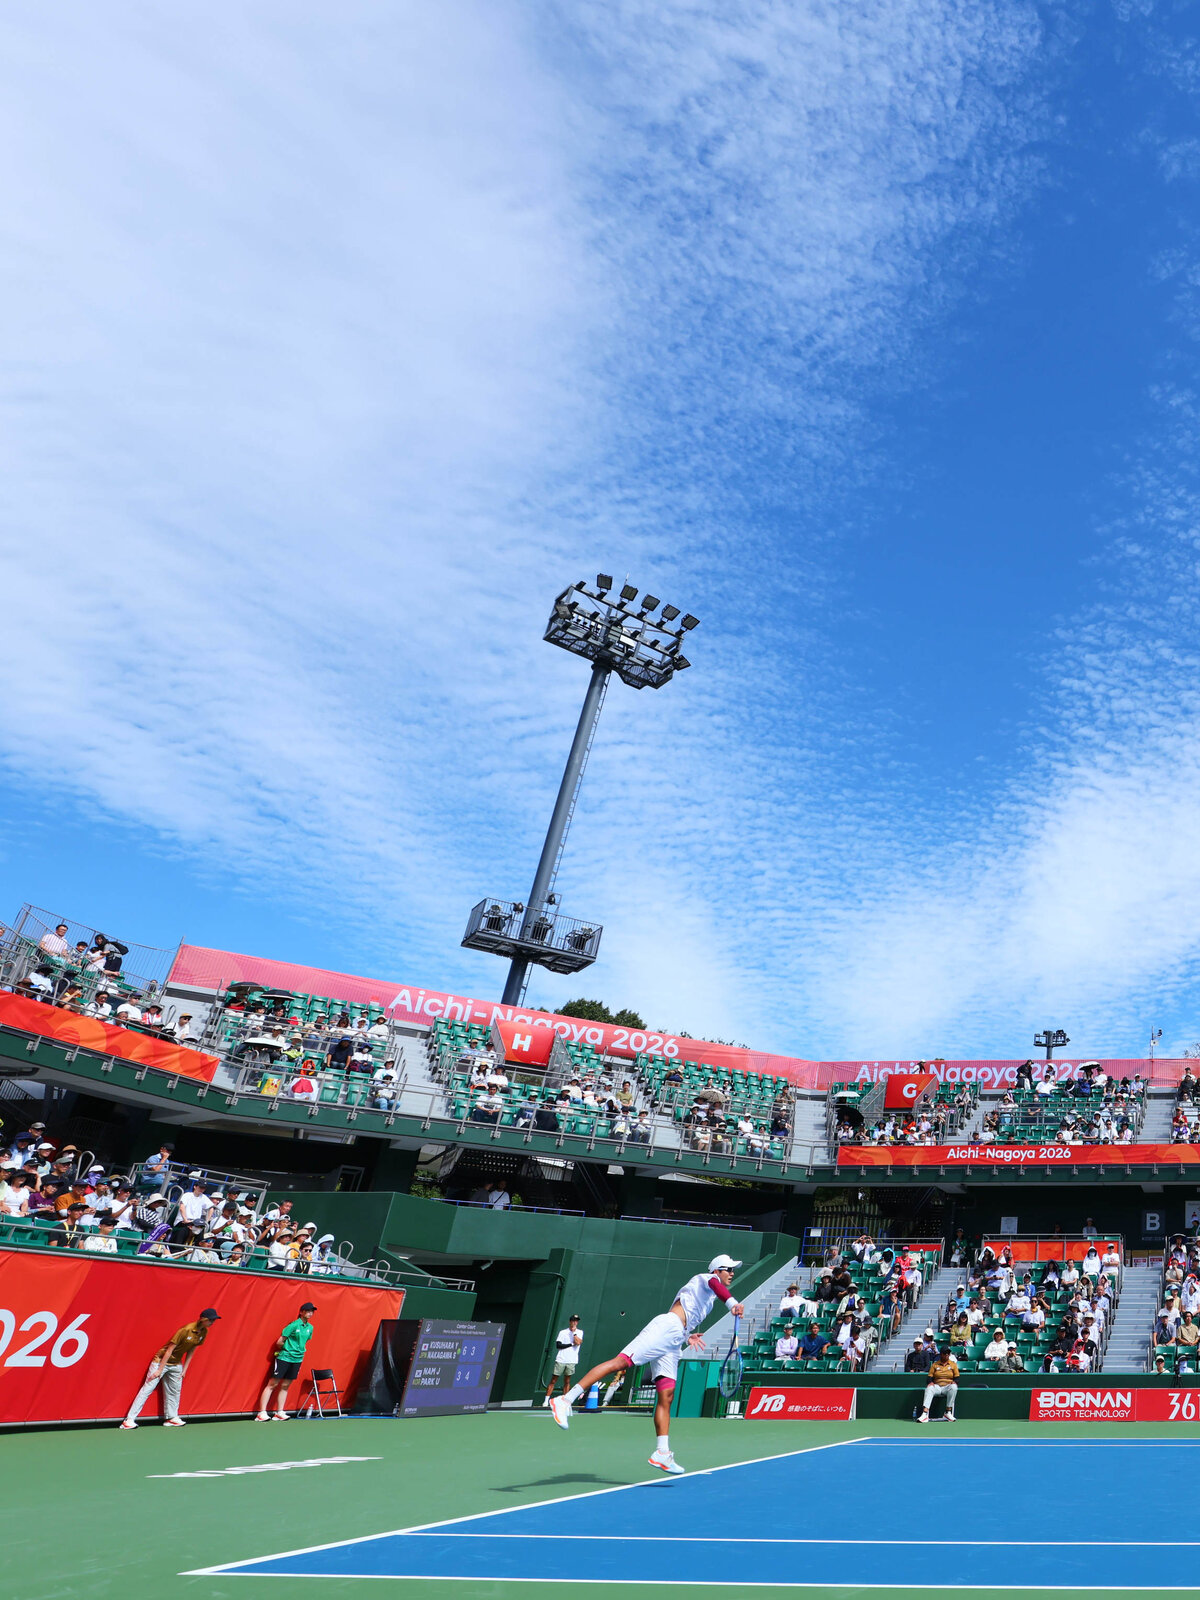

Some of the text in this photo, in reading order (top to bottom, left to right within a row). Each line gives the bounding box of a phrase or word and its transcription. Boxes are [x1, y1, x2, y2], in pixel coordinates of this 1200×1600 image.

[511, 1033, 532, 1052] H
[611, 1028, 679, 1058] 2026
[902, 1083, 918, 1099] G
[947, 1147, 1072, 1162] Aichi-Nagoya 2026
[1146, 1212, 1160, 1231] B
[429, 1341, 459, 1350] KUSUHARA Y
[427, 1351, 452, 1359] NAKAGAWA
[452, 1352, 457, 1360] S
[462, 1346, 496, 1356] 6 3 0
[423, 1368, 437, 1376] NAM
[456, 1371, 461, 1381] 3
[465, 1371, 470, 1381] 4
[420, 1378, 435, 1386] PARK
[750, 1394, 786, 1415] JTB
[1036, 1391, 1131, 1408] BORNAN
[787, 1405, 847, 1413] 感動のそばに、いつも。
[1038, 1409, 1131, 1418] SPORTS TECHNOLOGY
